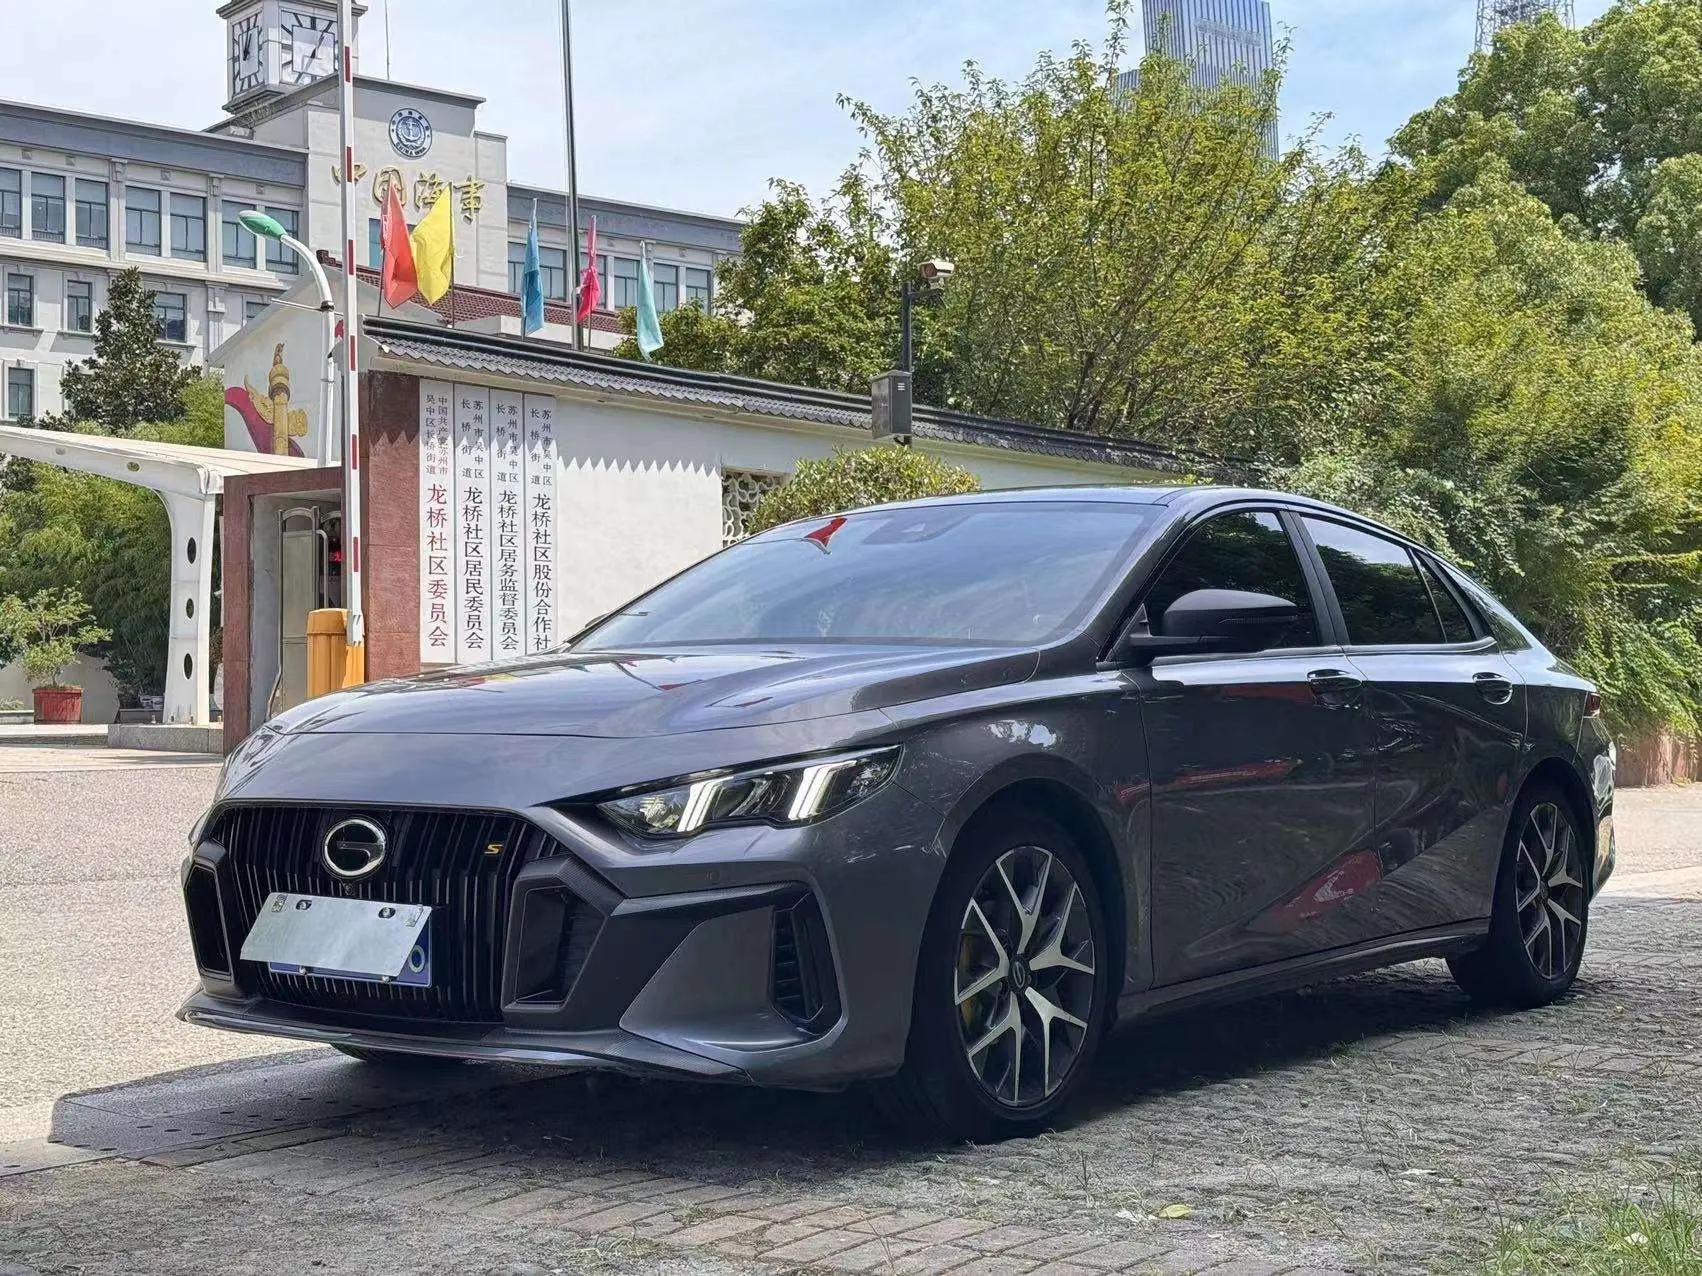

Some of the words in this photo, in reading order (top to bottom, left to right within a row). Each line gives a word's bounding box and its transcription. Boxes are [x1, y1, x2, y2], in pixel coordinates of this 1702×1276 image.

[427, 483, 448, 647] 龙桥社区委员会
[463, 486, 484, 649] 龙桥社区居民委员会
[498, 489, 519, 651] 龙桥社区居务监督委员会
[532, 493, 552, 652] 龙桥社区股份合作社
[484, 843, 504, 855] S
